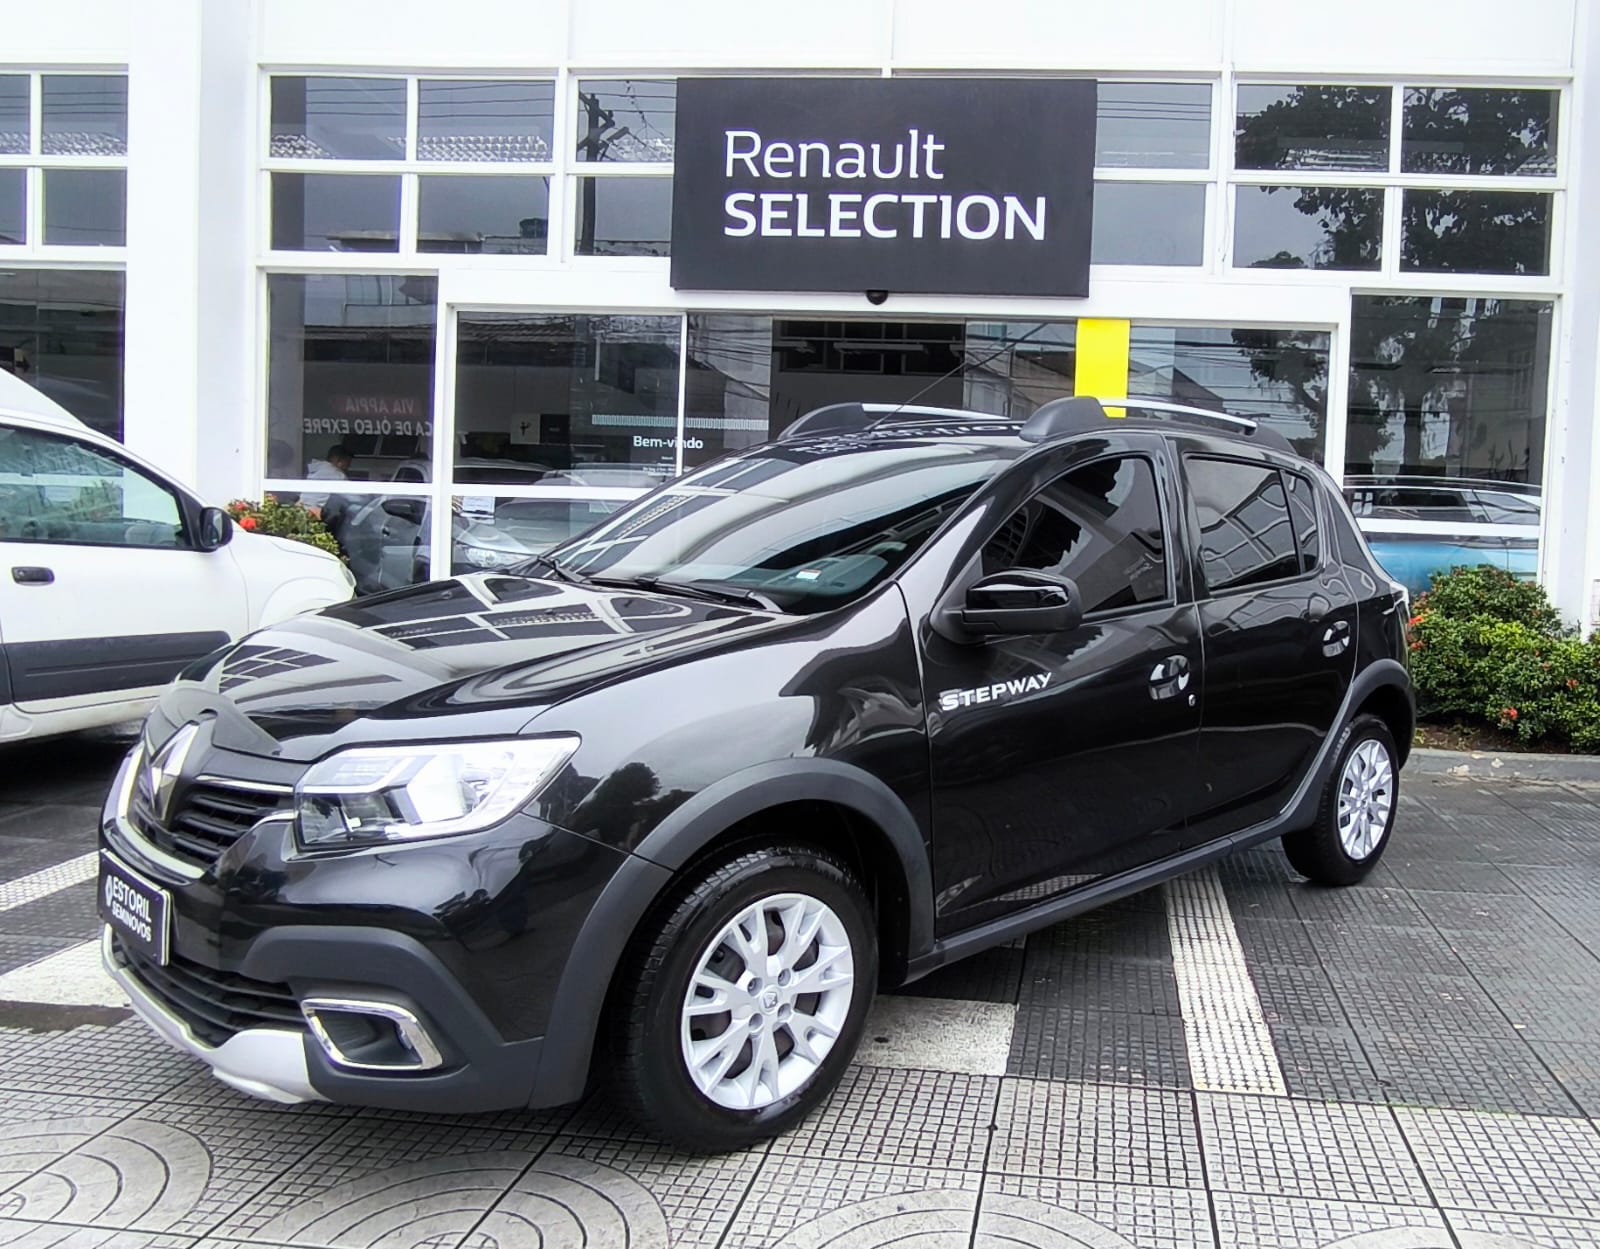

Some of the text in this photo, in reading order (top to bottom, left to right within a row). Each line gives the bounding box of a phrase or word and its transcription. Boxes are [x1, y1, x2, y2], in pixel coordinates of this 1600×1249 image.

[725, 129, 945, 179] Renault
[723, 193, 1047, 241] SELECTION
[941, 672, 1052, 711] STEPWAY
[111, 901, 151, 942] SEMINOVOS
[113, 877, 151, 923] ESTORIL
